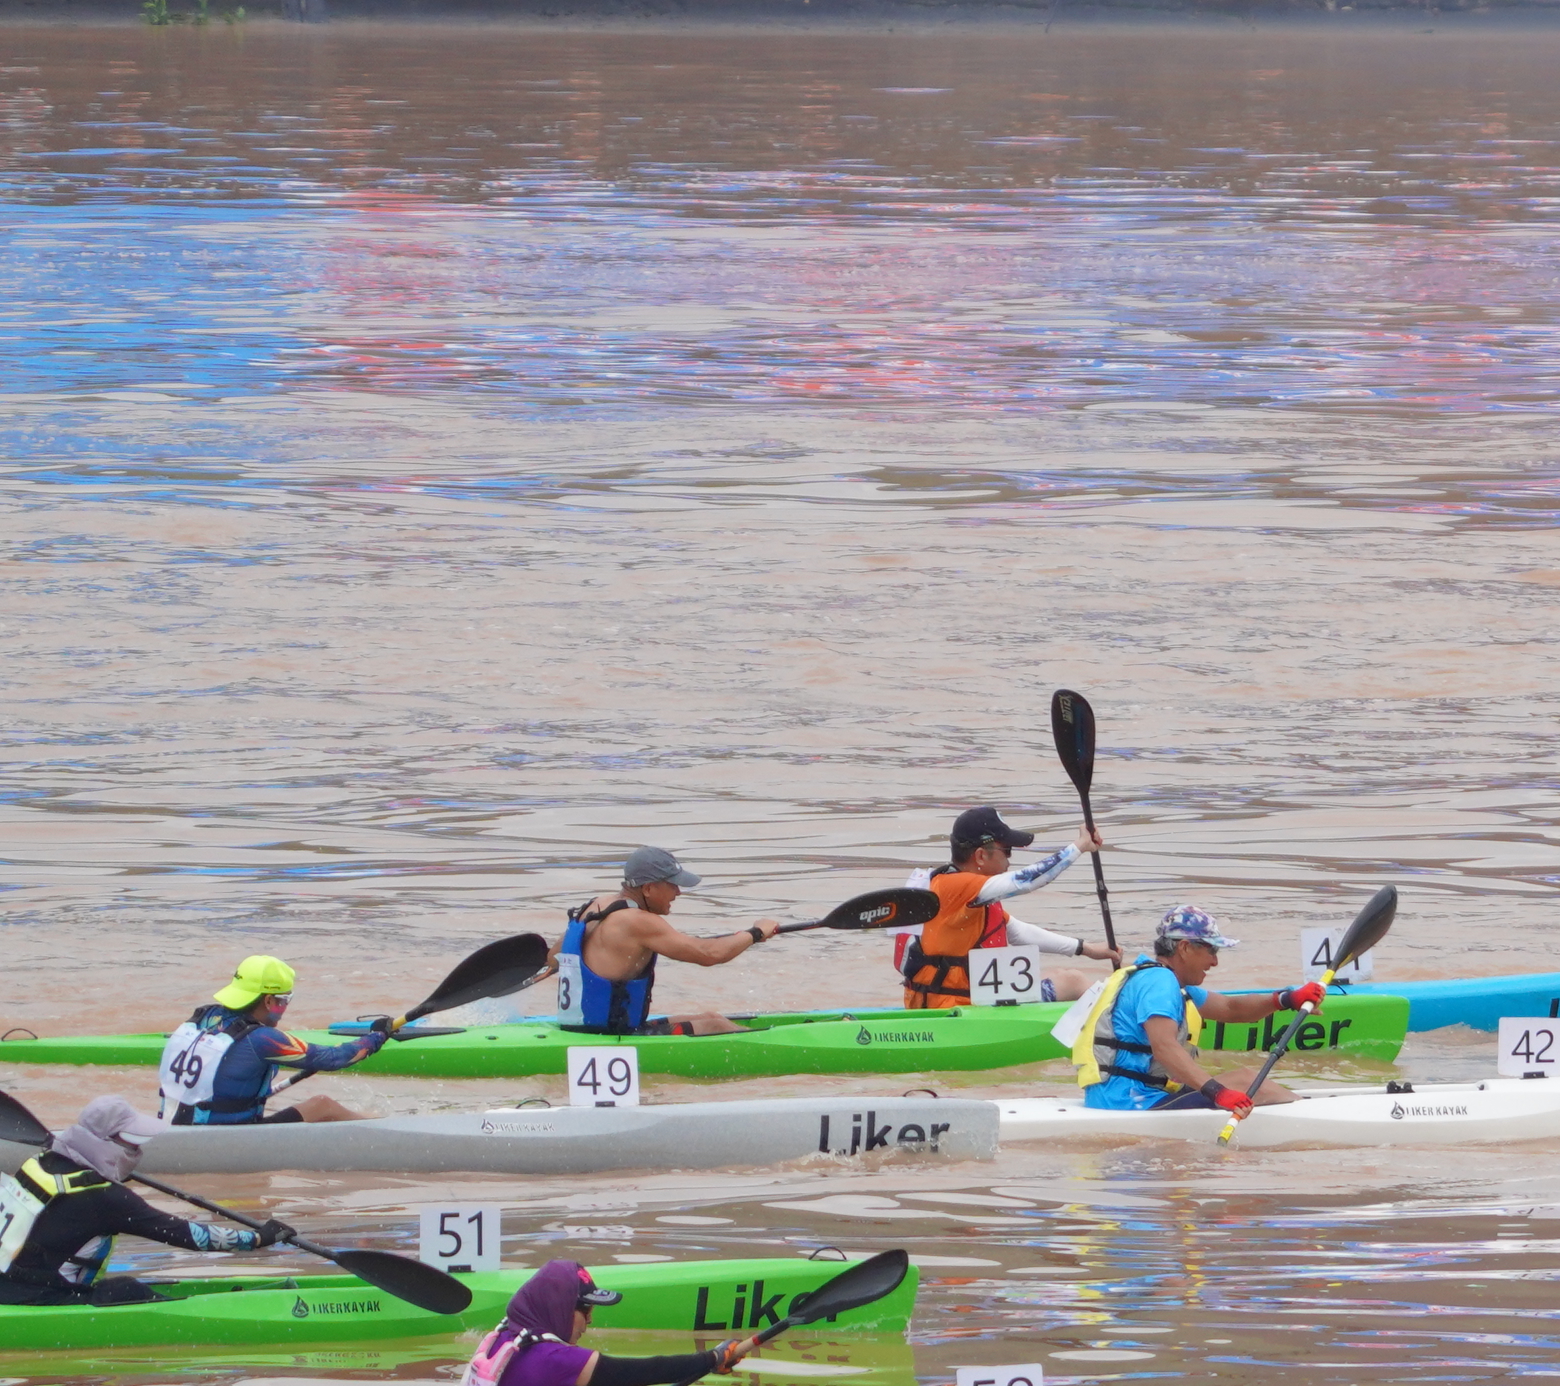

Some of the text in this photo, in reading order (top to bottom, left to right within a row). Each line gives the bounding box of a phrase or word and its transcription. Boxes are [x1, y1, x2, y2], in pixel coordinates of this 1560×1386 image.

[859, 905, 891, 923] epic
[556, 975, 571, 1011] 3
[977, 955, 1034, 996] 43
[1214, 1011, 1353, 1053] Liker
[1511, 1029, 1555, 1064] 42
[168, 1049, 204, 1090] 49
[576, 1057, 632, 1098] 49
[819, 1110, 951, 1158] Liker
[438, 1210, 483, 1258] 51
[693, 1278, 840, 1334] Like
